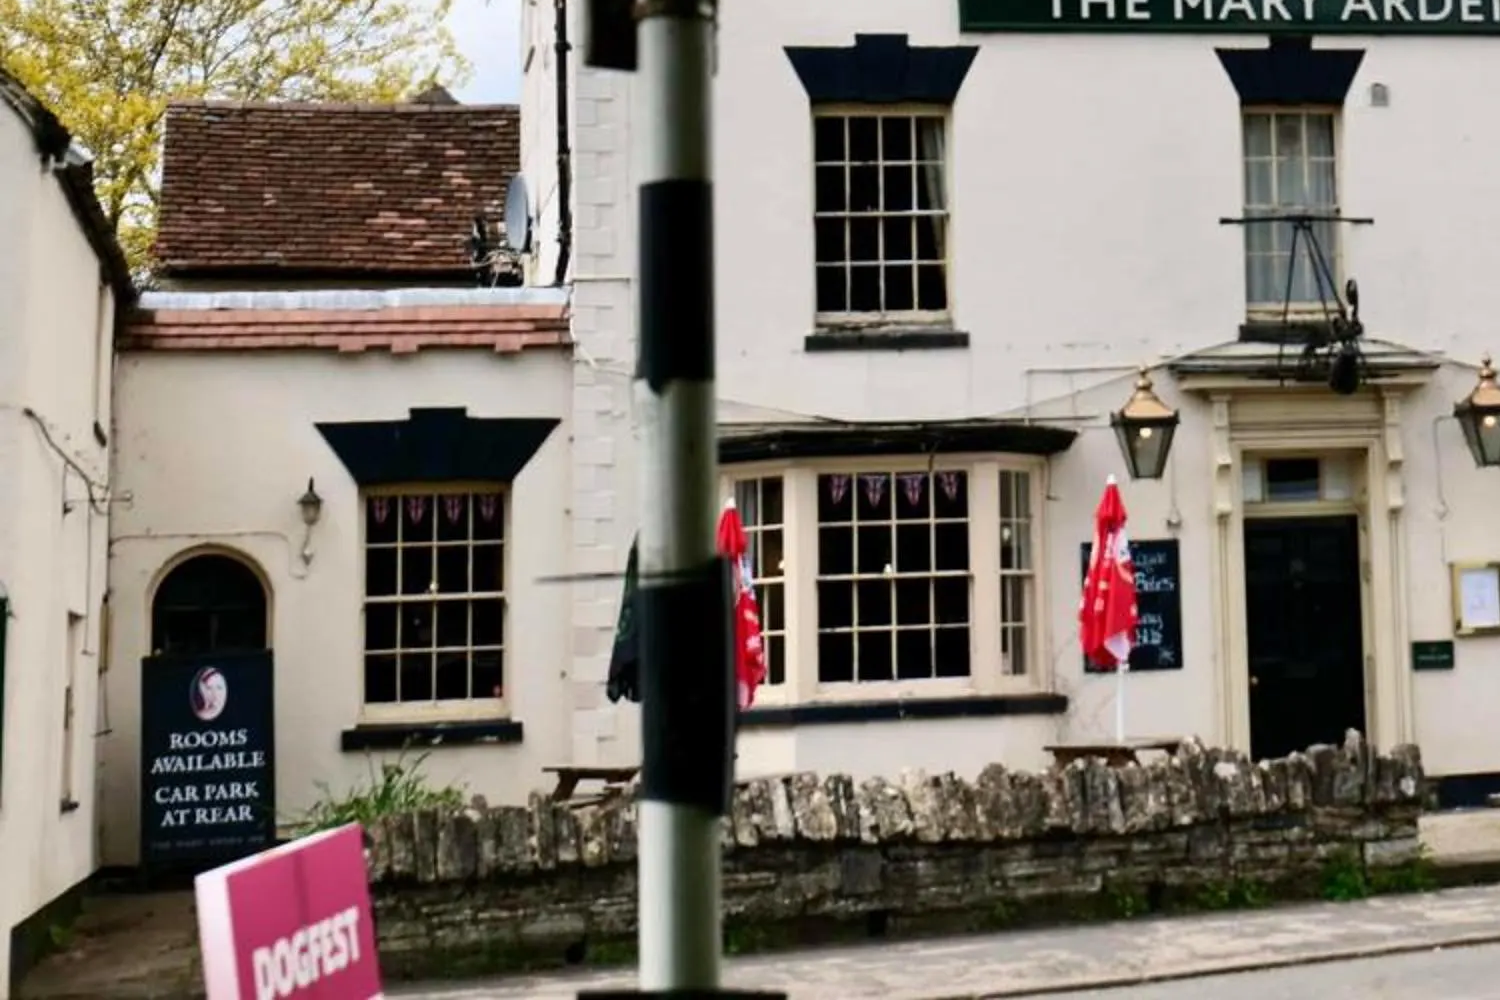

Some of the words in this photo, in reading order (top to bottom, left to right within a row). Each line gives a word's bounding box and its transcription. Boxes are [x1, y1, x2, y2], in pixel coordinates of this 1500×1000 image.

[170, 729, 248, 749] ROOMS
[151, 751, 265, 774] AVAILABLE
[155, 784, 199, 804] CAR
[203, 781, 260, 801] PARK
[161, 809, 190, 828] AT
[194, 804, 254, 825] REAR
[252, 905, 360, 1000] DOGFEST
